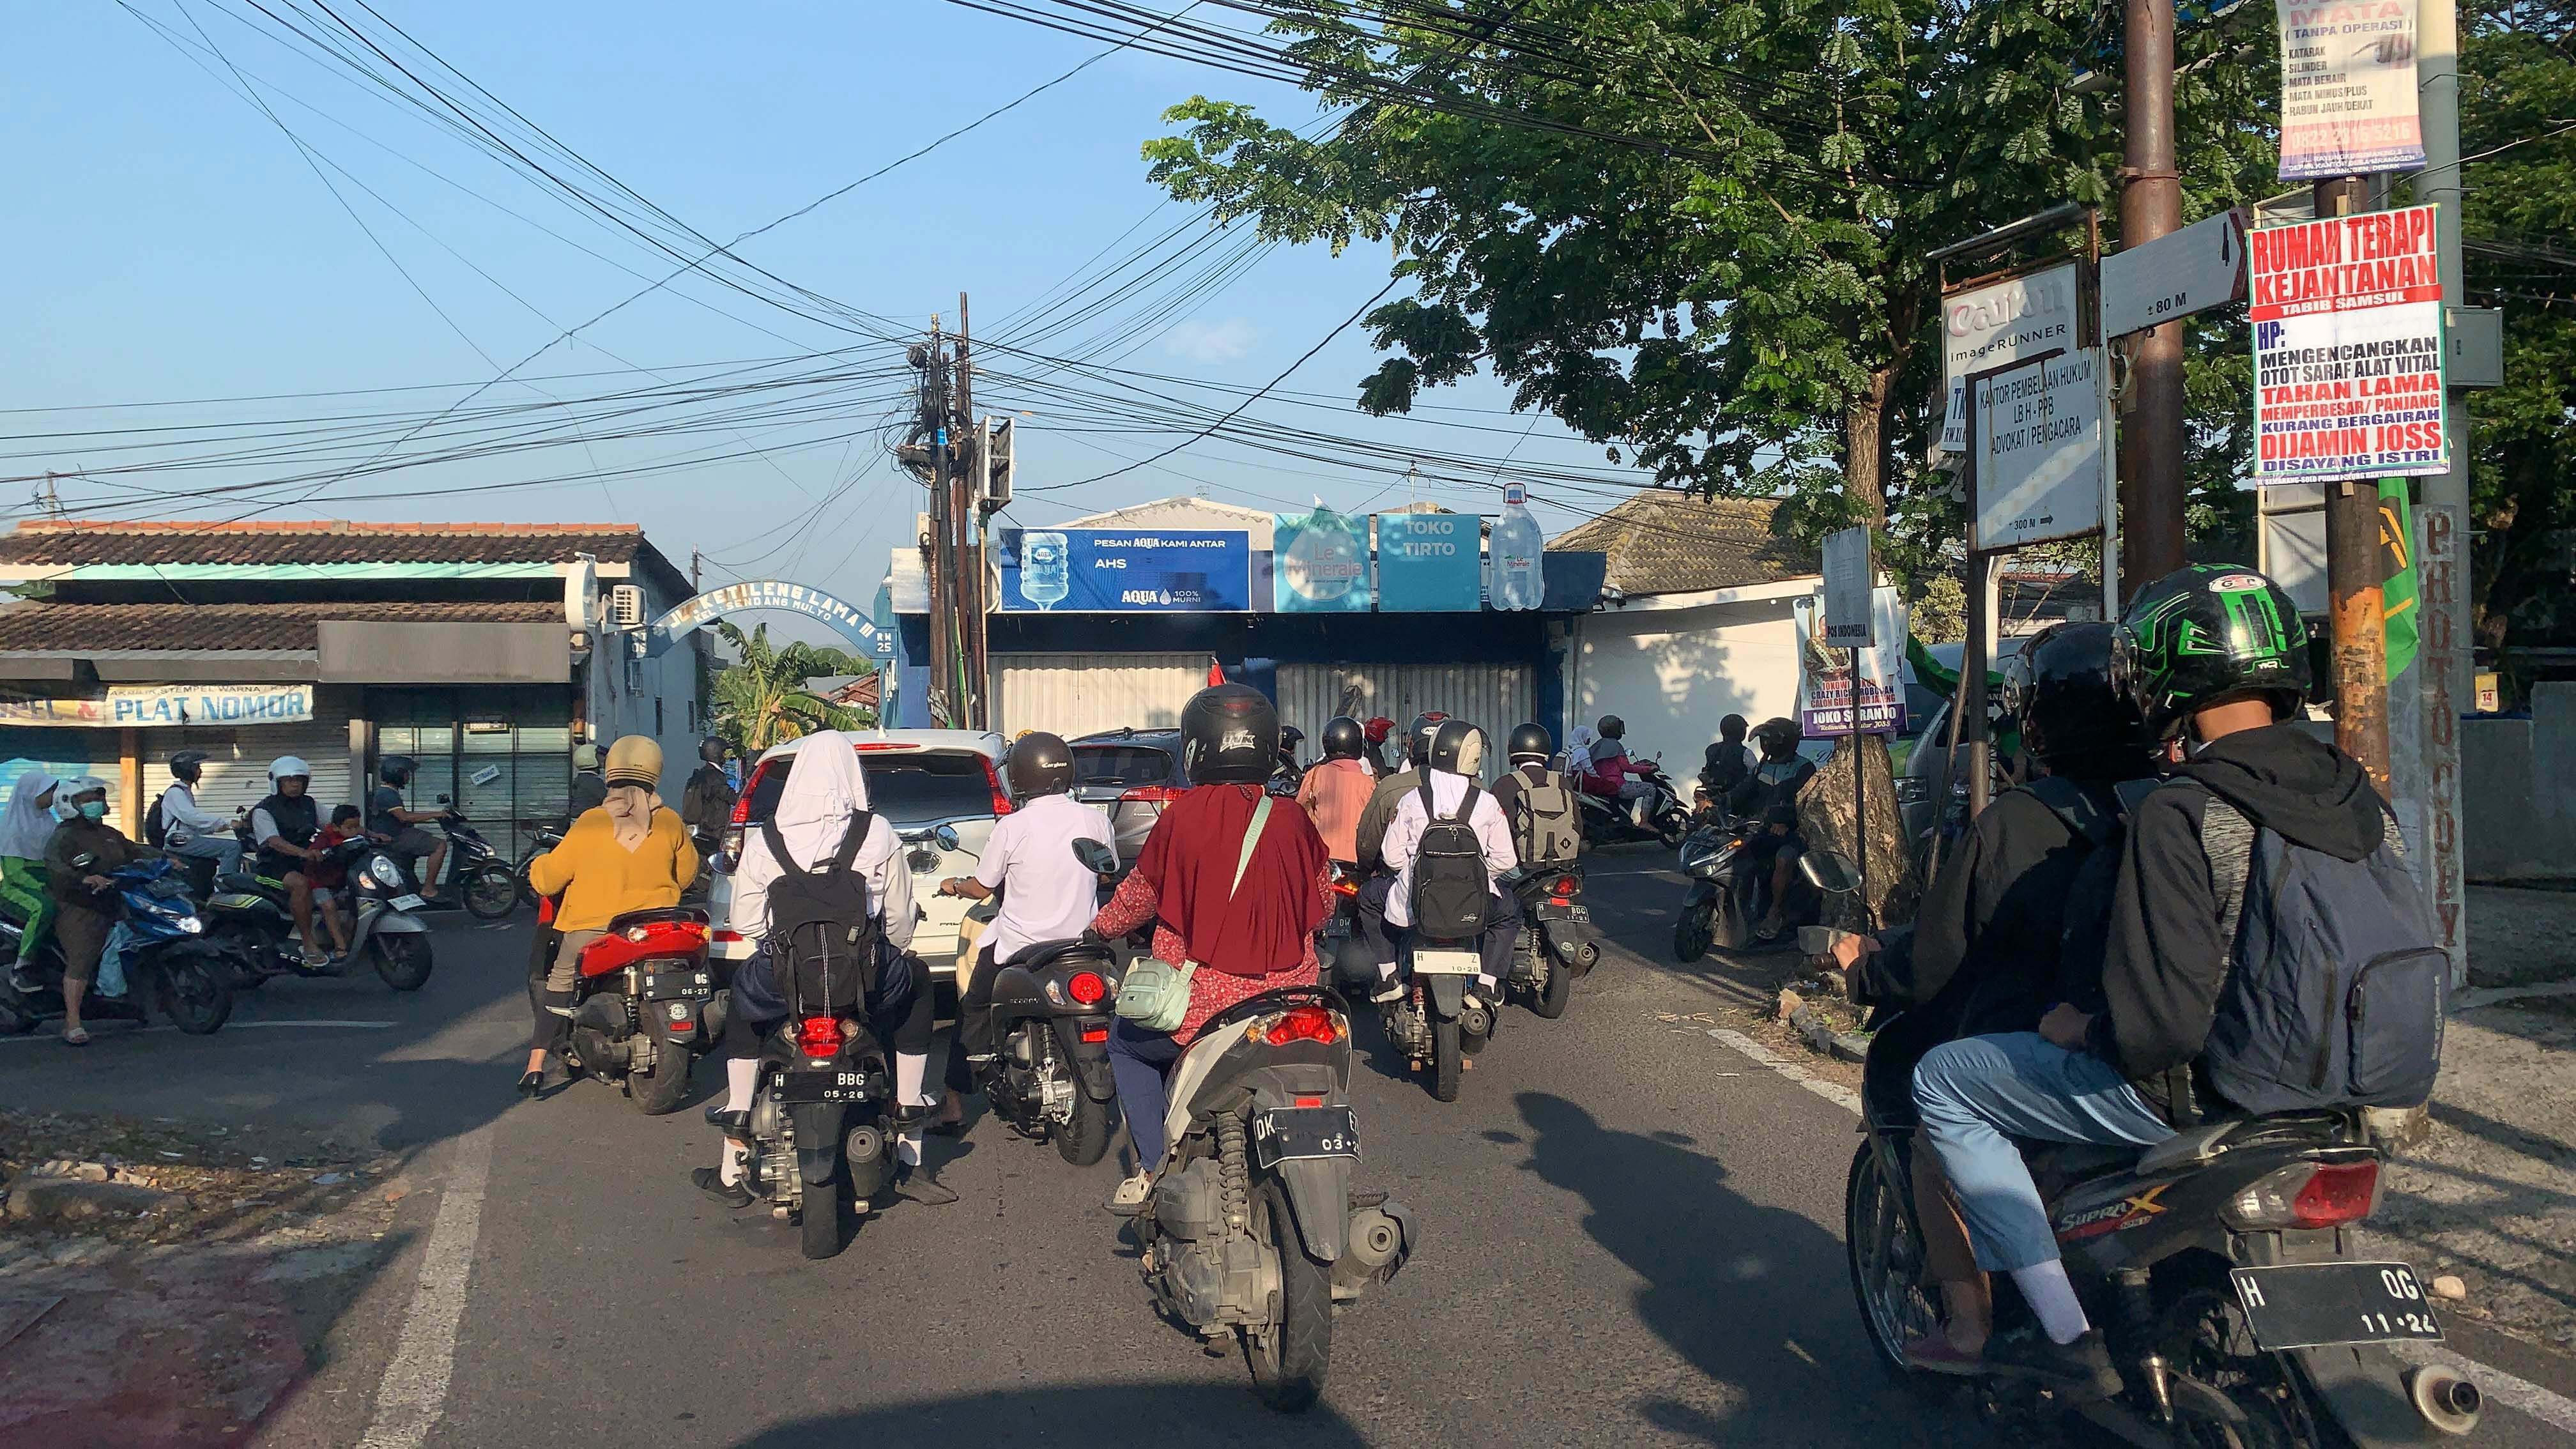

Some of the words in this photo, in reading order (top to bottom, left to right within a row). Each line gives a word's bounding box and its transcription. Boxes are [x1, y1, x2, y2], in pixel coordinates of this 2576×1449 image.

[2290, 1, 2403, 26] MATA
[2294, 26, 2338, 38] TANPA
[2342, 20, 2402, 34] OPERASI
[2289, 46, 2326, 59] KATARAK
[2289, 61, 2327, 73] SILINDER
[2289, 77, 2312, 88] MATA
[2315, 73, 2346, 85] BERAIR
[2289, 91, 2313, 102] MATA
[2315, 86, 2367, 99] MINUS/PLUS
[2290, 104, 2318, 116] RABUN
[2321, 100, 2373, 114] JAUH/DEKAT
[2253, 221, 2340, 275] RUMAH
[2347, 208, 2435, 260] TERAPI
[2255, 254, 2436, 305] KEJANTANAN
[2156, 298, 2171, 313] 80
[2175, 292, 2186, 307] M
[2281, 300, 2331, 316] TABIB
[2336, 291, 2406, 309] SAMSUL
[1951, 324, 2066, 362] imageRUNNER
[2258, 321, 2285, 350] HP:
[2260, 337, 2437, 369] MENGENCANGKAN
[2260, 366, 2299, 386] OTOT
[2303, 361, 2351, 381] SARAF
[2354, 358, 2392, 377] ALAT
[2396, 354, 2440, 373] VITAL
[1981, 384, 2010, 410] KANTOR
[2012, 369, 2058, 401] PEMBELAAN
[2060, 359, 2091, 385] HUKUM
[2260, 381, 2350, 404] TAHAN
[2359, 373, 2440, 396] LAMA
[2038, 395, 2054, 418] PPB
[2376, 394, 2439, 412] PANJANG
[2262, 418, 2333, 433] KURANG
[2338, 409, 2439, 428] BERGAIRAH
[1992, 429, 2025, 456] ADVOKAT
[2032, 415, 2082, 446] PENGACARA
[2260, 429, 2367, 460] DIJAMIN
[2375, 422, 2441, 453] JOSS
[2264, 454, 2370, 471] DISAYANG
[2379, 450, 2439, 464] ISTRI
[1404, 521, 1455, 535] TOKO
[2014, 519, 2027, 530] 300
[1133, 538, 1160, 549] AQUA
[1190, 540, 1226, 548] ANTAR
[1314, 542, 1335, 560] Le
[1403, 542, 1456, 556] TIRTO
[1094, 559, 1127, 569] AHS
[1288, 558, 1363, 576] Minerale
[1121, 590, 1158, 605] AQUA
[698, 582, 803, 610] KETILENG
[809, 592, 859, 627] LAMA
[859, 622, 876, 638] III
[725, 597, 788, 610] SENDANG
[792, 601, 832, 621] MULYO
[1827, 625, 1837, 638] POS
[1838, 624, 1867, 638] INDONESIA
[2425, 512, 2453, 746] PHOTO
[877, 643, 891, 652] 25
[160, 686, 212, 694] STEMPEL
[1811, 691, 1833, 700] CRAZY
[2483, 693, 2492, 701] 14
[114, 696, 190, 721] PLAT
[201, 692, 305, 721] NOMOR
[1811, 699, 1832, 709] CALON
[1813, 710, 1841, 724] JOKO
[1873, 720, 1891, 729] JOSS
[1417, 953, 1423, 961] H
[1471, 954, 1477, 963] Z
[646, 976, 654, 986] H
[775, 1074, 784, 1087] H
[838, 1073, 864, 1085] BBG
[1256, 1114, 1276, 1141] DK
[2120, 1184, 2170, 1221] X
[2240, 1276, 2266, 1307] H
